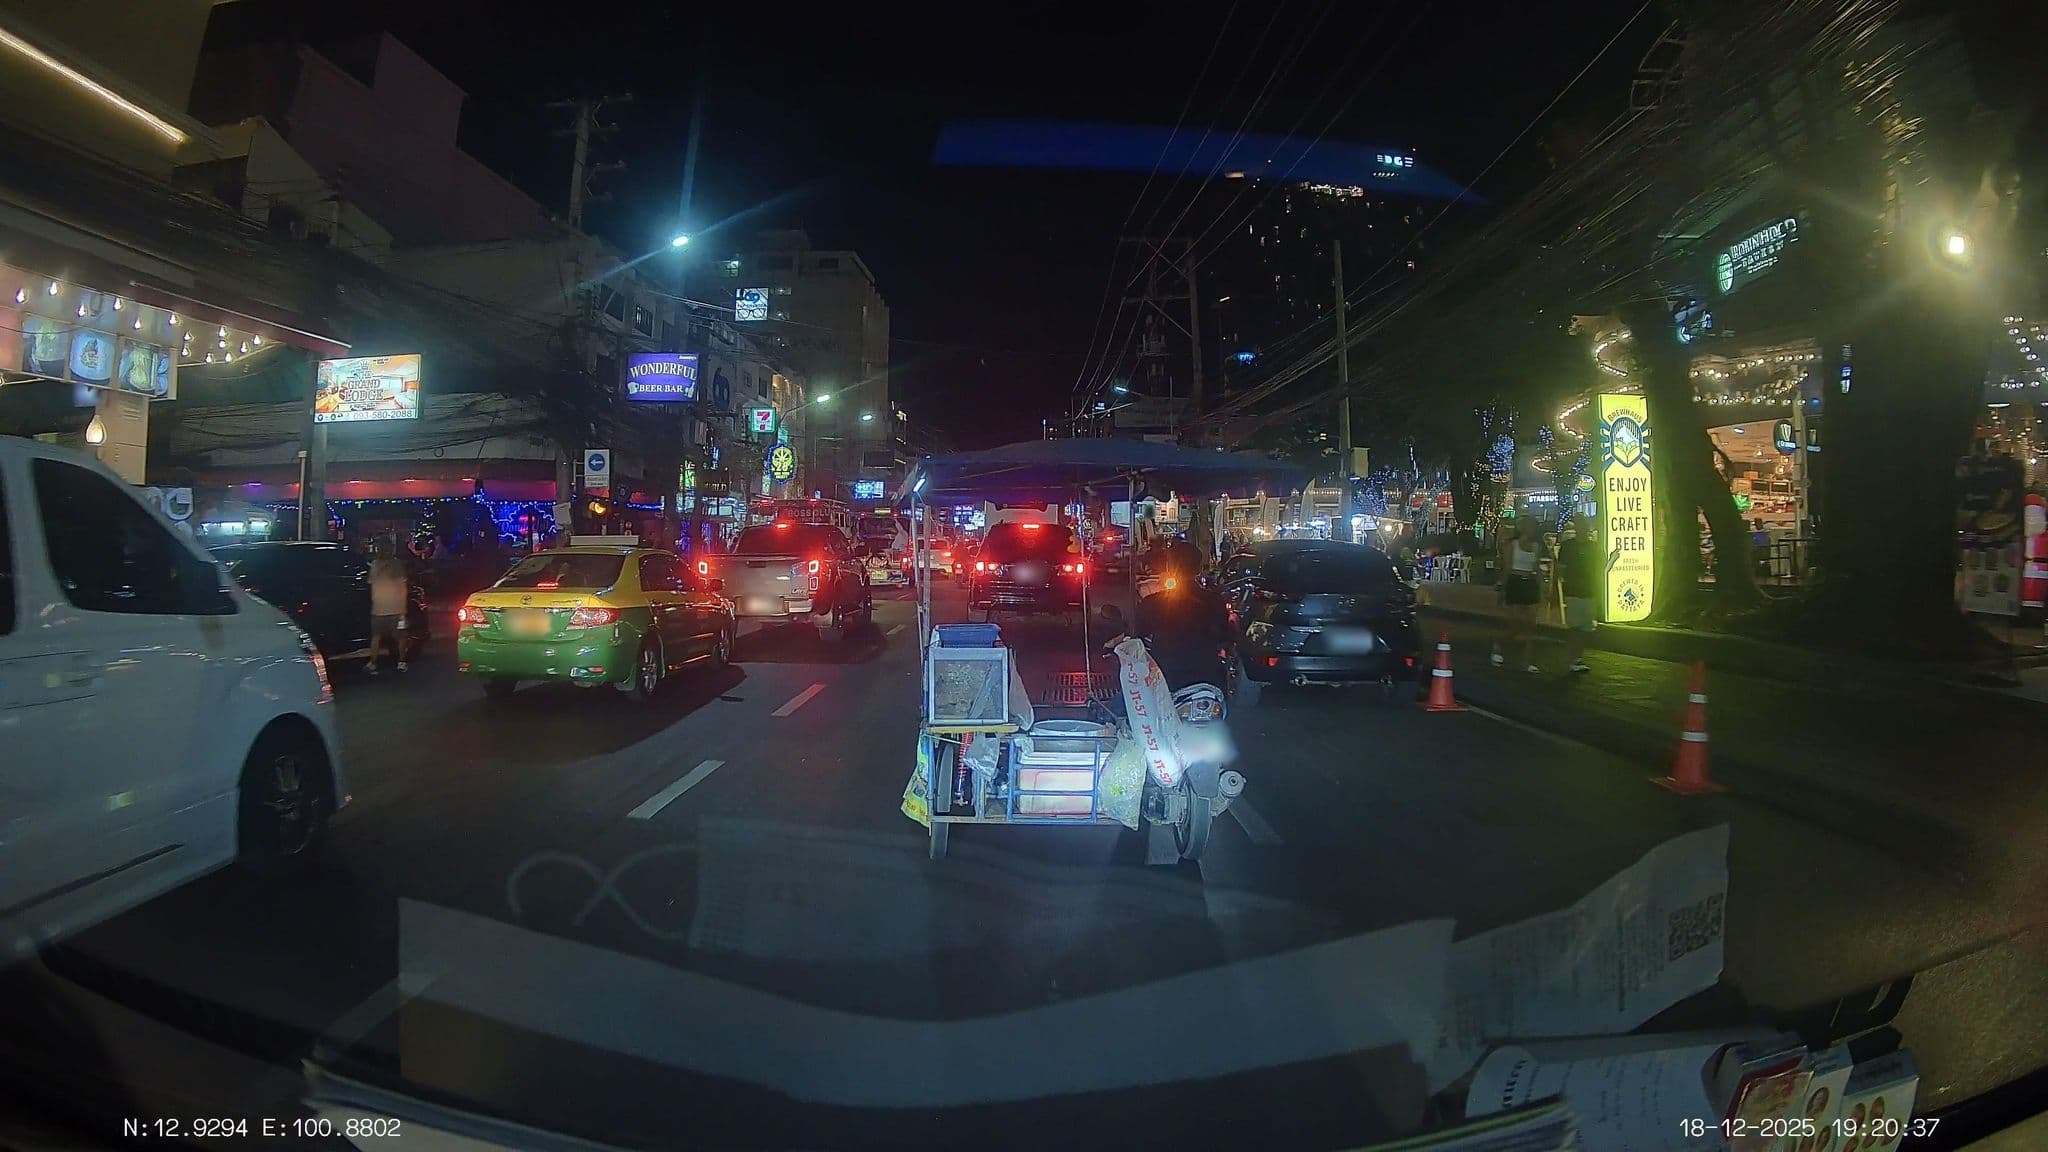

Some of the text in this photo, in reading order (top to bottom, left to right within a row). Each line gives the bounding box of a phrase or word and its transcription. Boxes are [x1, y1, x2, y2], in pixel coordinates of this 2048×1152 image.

[1377, 154, 1414, 168] EDGE
[630, 362, 697, 380] WONDERFUL
[347, 379, 381, 390] GRAND
[639, 384, 683, 392] BEER BAR
[345, 389, 384, 402] LODGE
[1609, 477, 1647, 492] ENJOY
[1616, 497, 1642, 512] LIVE
[1611, 517, 1648, 532] CRAFT
[1616, 536, 1645, 551] BEER
[1129, 690, 1147, 717] JT-57
[1142, 724, 1159, 751] JT-57
[1154, 759, 1173, 784] JT-57
